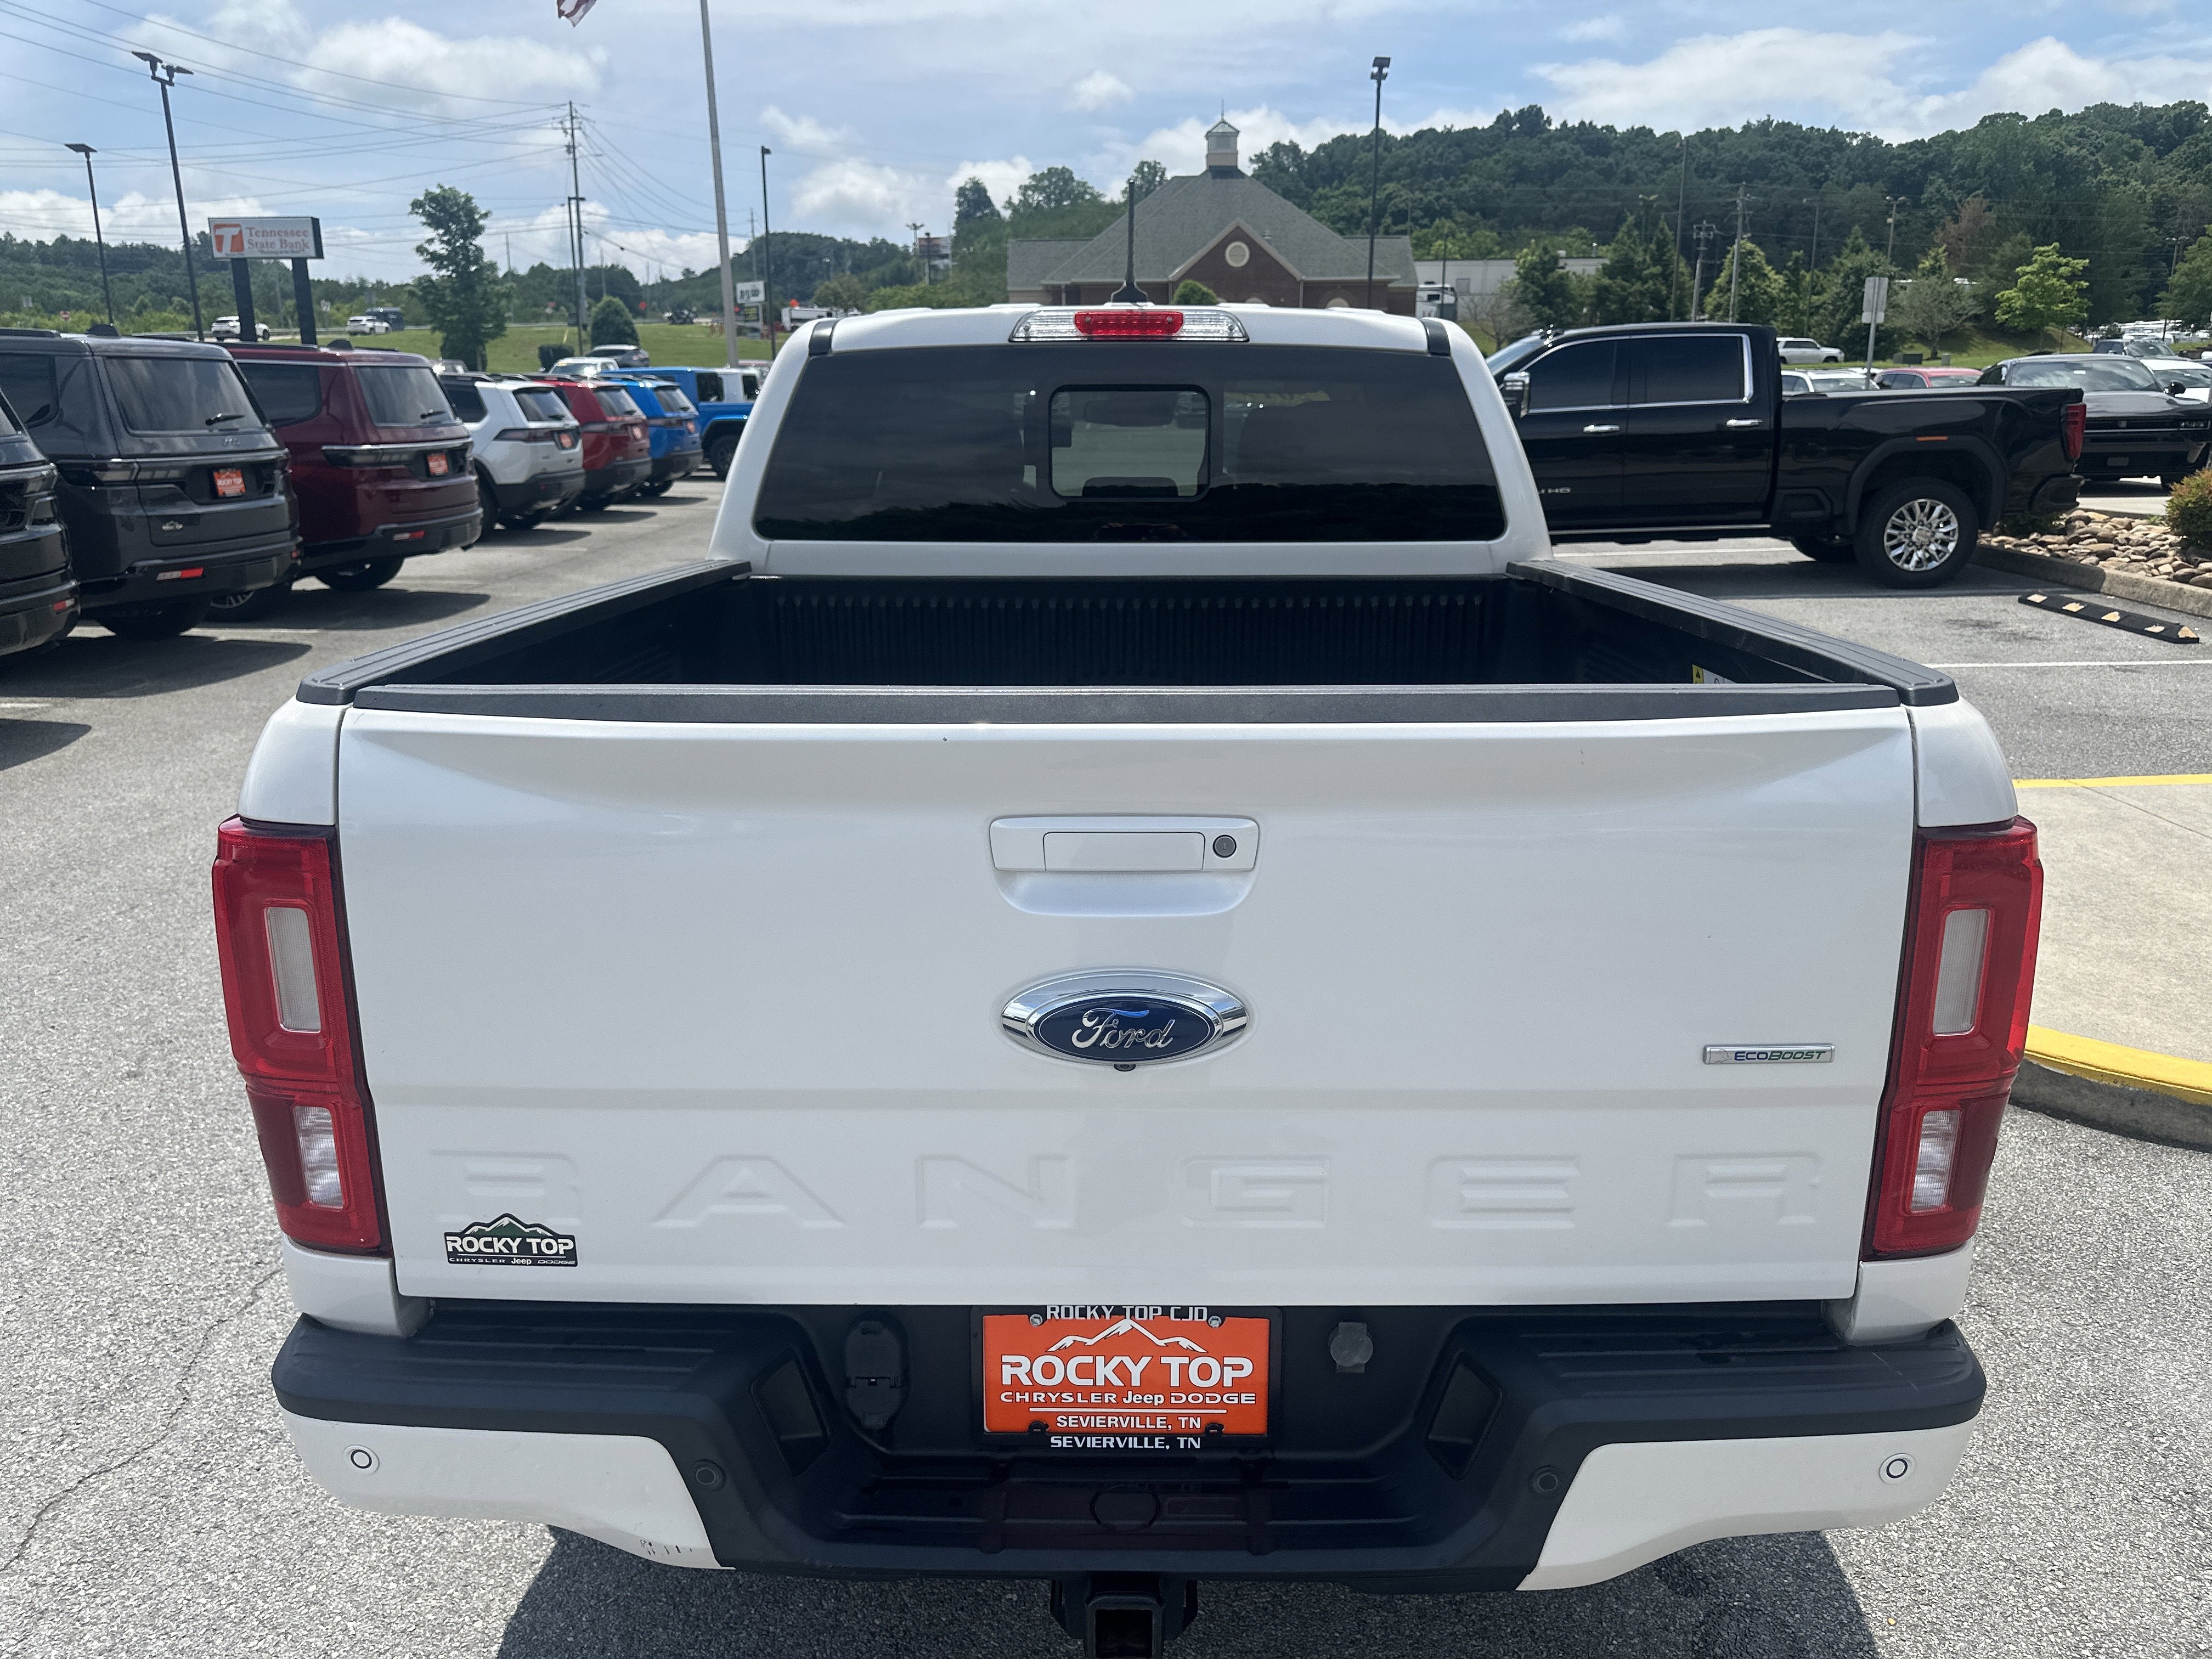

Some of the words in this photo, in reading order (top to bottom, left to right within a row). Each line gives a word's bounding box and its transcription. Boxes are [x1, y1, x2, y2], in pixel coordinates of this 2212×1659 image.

[245, 227, 309, 238] Tennessee
[247, 238, 276, 250] State
[279, 238, 310, 250] Bank
[1071, 1007, 1176, 1049] Ford
[430, 1149, 1821, 1229] RANGER
[445, 1236, 522, 1254] ROCKY
[526, 1238, 574, 1255] TOP
[511, 1257, 532, 1266] Jeep
[1046, 1305, 1120, 1320] ROCKY
[1122, 1305, 1162, 1321] TOP
[1170, 1306, 1209, 1322] CJD
[1001, 1355, 1153, 1387] ROCKY
[1160, 1356, 1254, 1387] TOP
[1000, 1391, 1117, 1404] CHRYSLER
[1122, 1391, 1165, 1406] Jeep
[1170, 1392, 1257, 1404] DODGE
[1056, 1416, 1172, 1431] SEVIERVILLE,
[1178, 1417, 1201, 1429] TN
[1051, 1436, 1170, 1450] SEVIERVILLE,
[1176, 1437, 1200, 1449] TN
